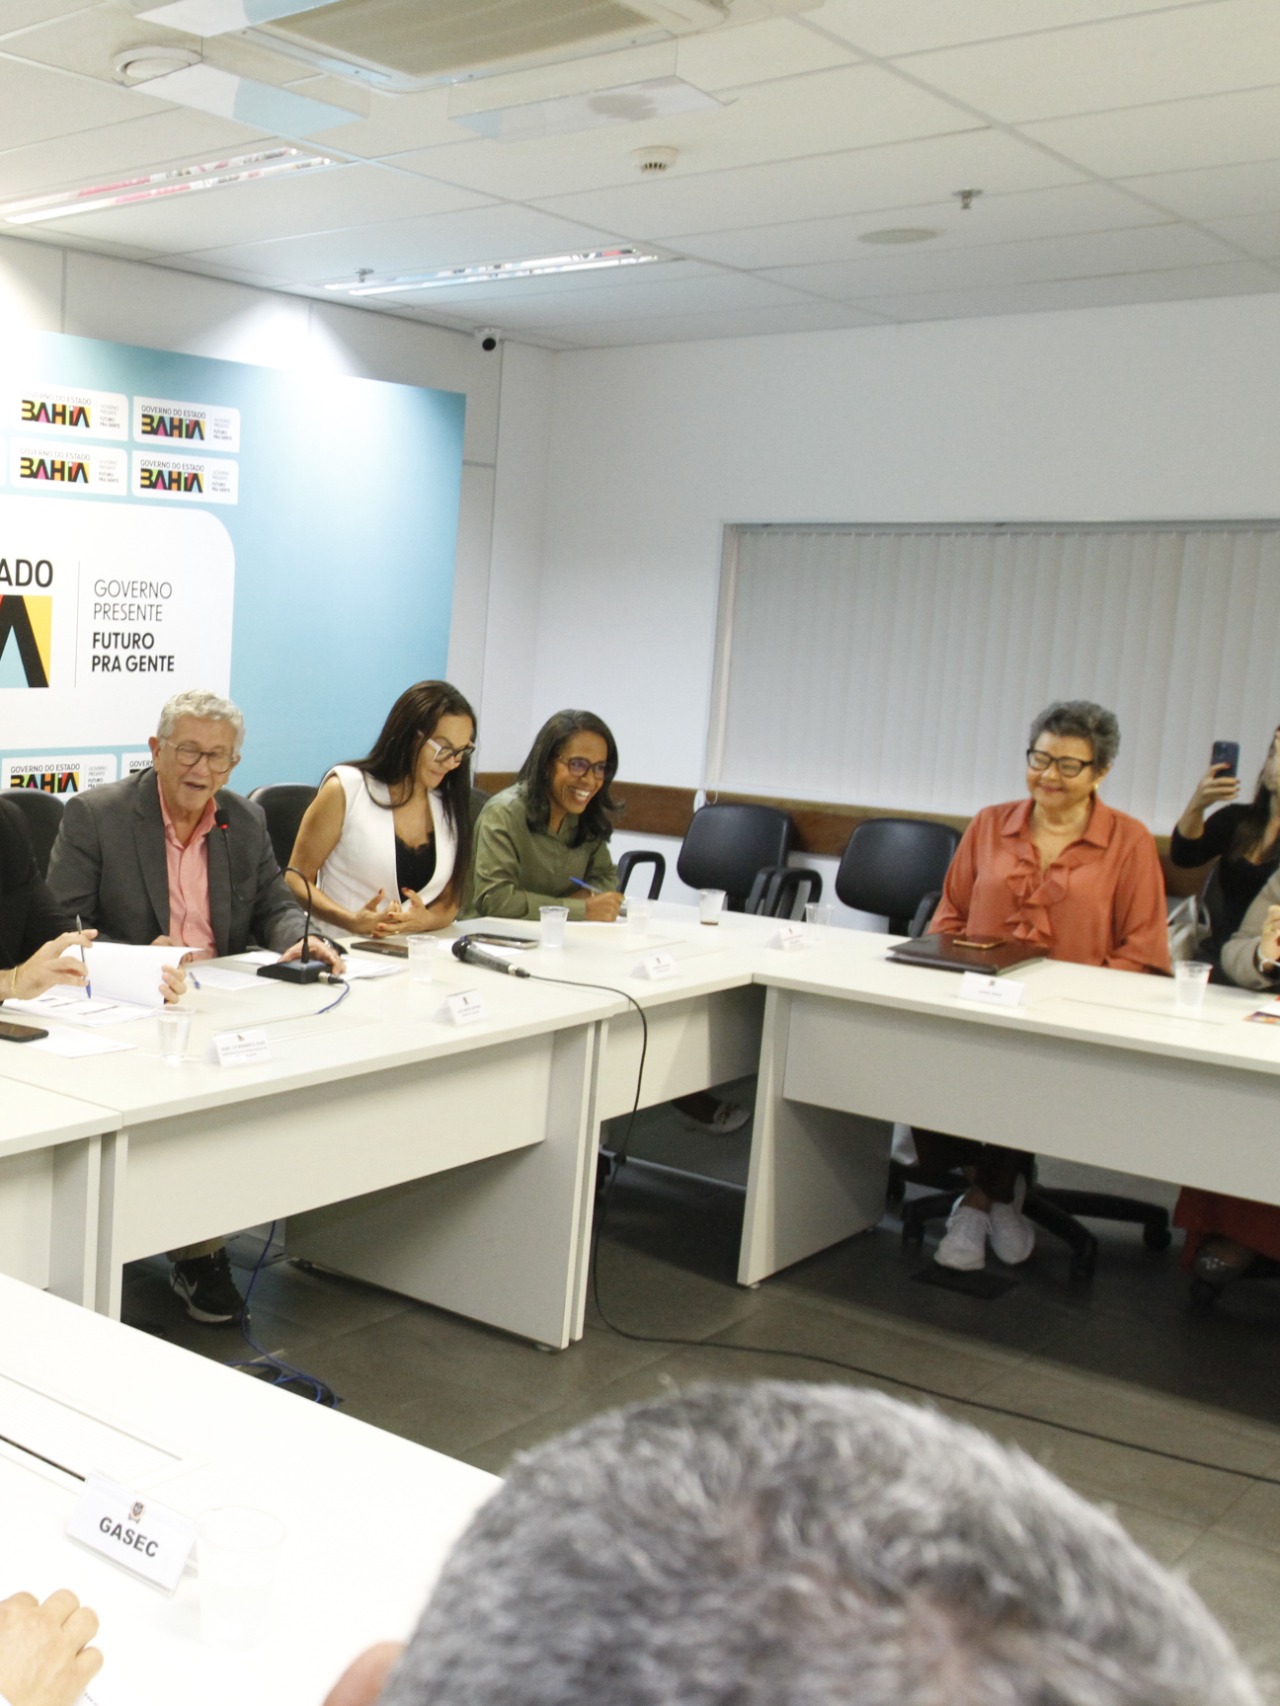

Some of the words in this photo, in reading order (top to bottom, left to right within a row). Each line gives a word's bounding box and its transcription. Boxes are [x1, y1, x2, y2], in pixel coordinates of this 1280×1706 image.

[22, 400, 91, 429] BAHIA
[142, 404, 171, 415] GOVERNO
[173, 408, 182, 416] DO
[183, 410, 205, 419] ESTADO
[142, 413, 205, 441] BAHIA
[66, 453, 89, 461] ESTADO
[140, 460, 170, 469] GOVERNO
[172, 462, 180, 470] DO
[182, 463, 204, 472] ESTADO
[20, 457, 89, 484] BAHIA
[140, 468, 204, 494] BAHIA
[94, 579, 173, 600] GOVERNO
[93, 602, 163, 622] PRESENTE
[92, 632, 155, 651] FUTURO
[91, 654, 121, 673] PRA
[124, 654, 175, 673] GENTE
[45, 764, 54, 772] DO
[56, 763, 80, 771] ESTADO
[99, 1516, 159, 1558] GASEC
